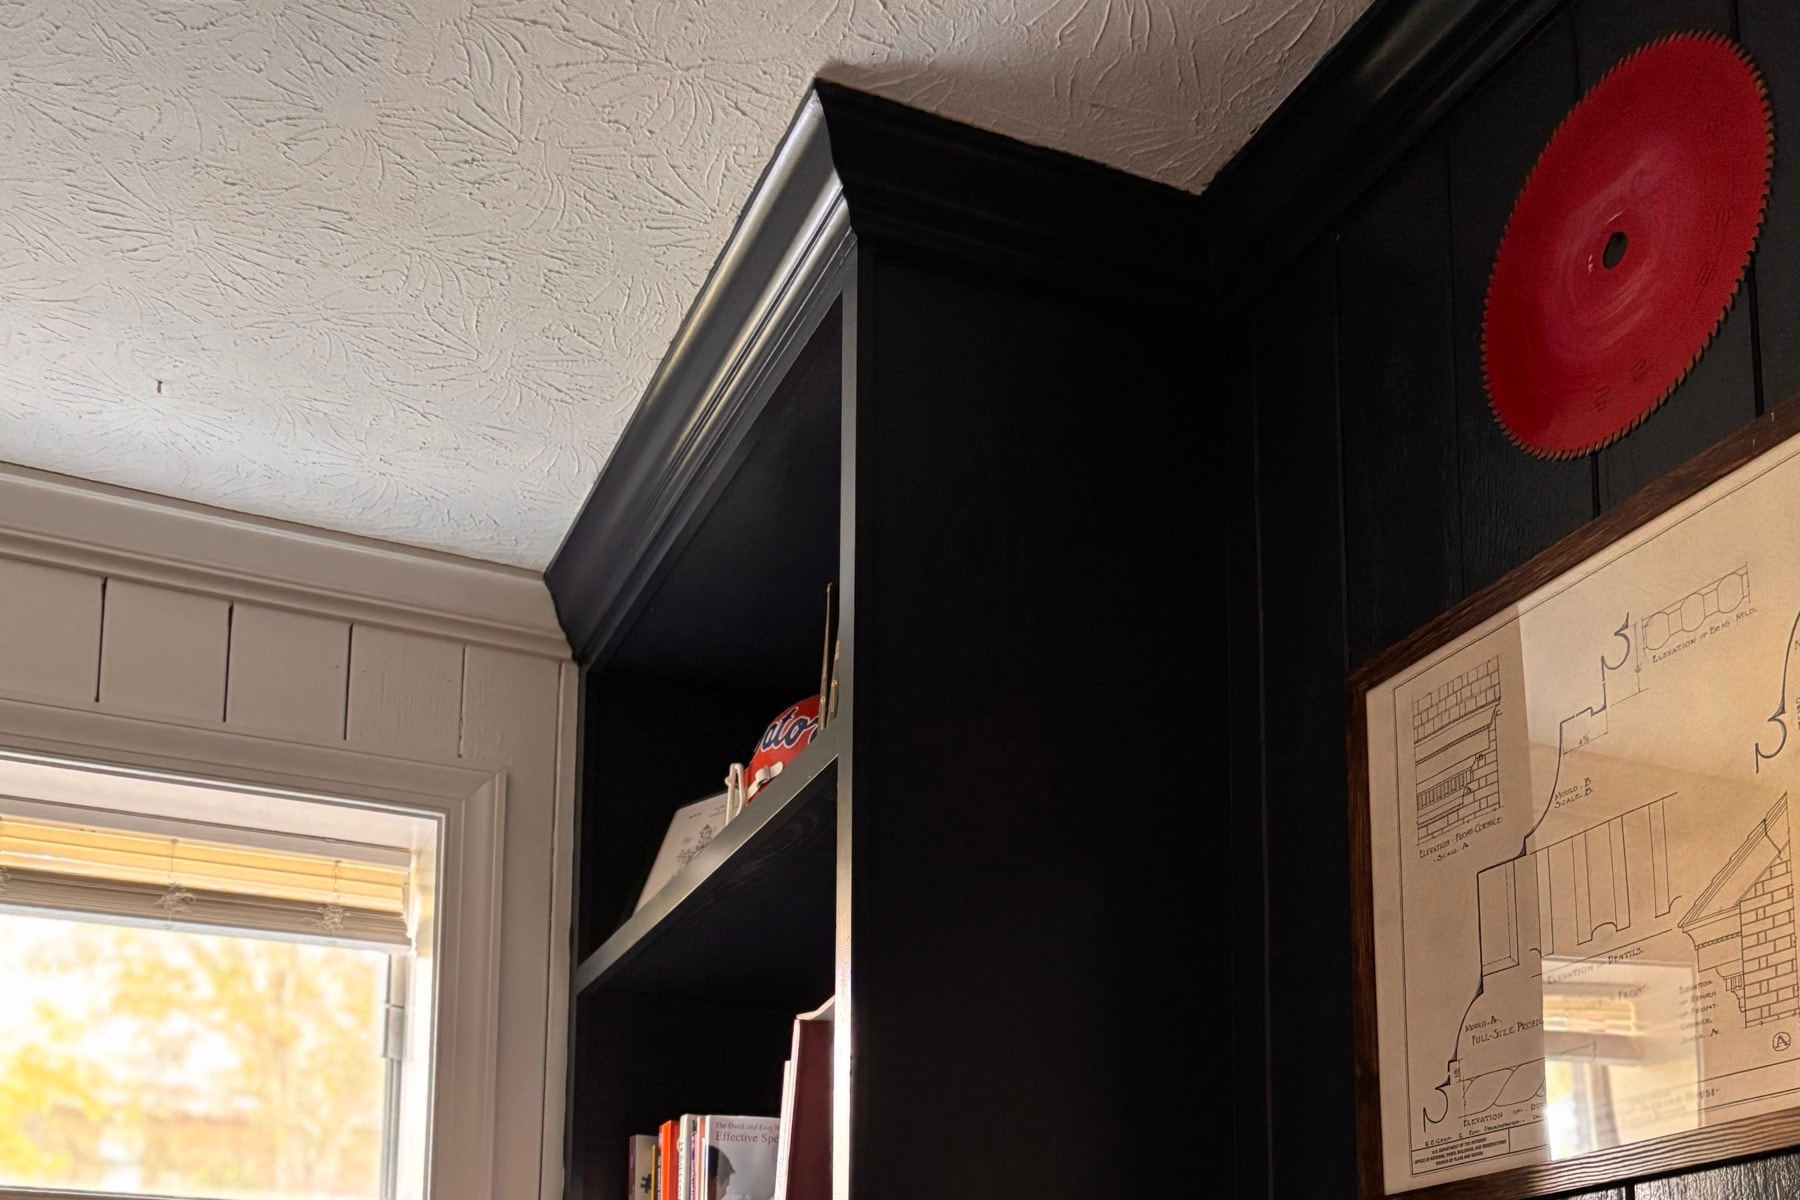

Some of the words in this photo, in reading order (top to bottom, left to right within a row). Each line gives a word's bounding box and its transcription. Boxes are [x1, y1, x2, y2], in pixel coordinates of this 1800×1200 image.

[758, 705, 820, 752] ato
[1463, 1111, 1504, 1128] ELEVATION
[715, 1130, 758, 1143] Effective
[761, 1133, 780, 1145] Spe
